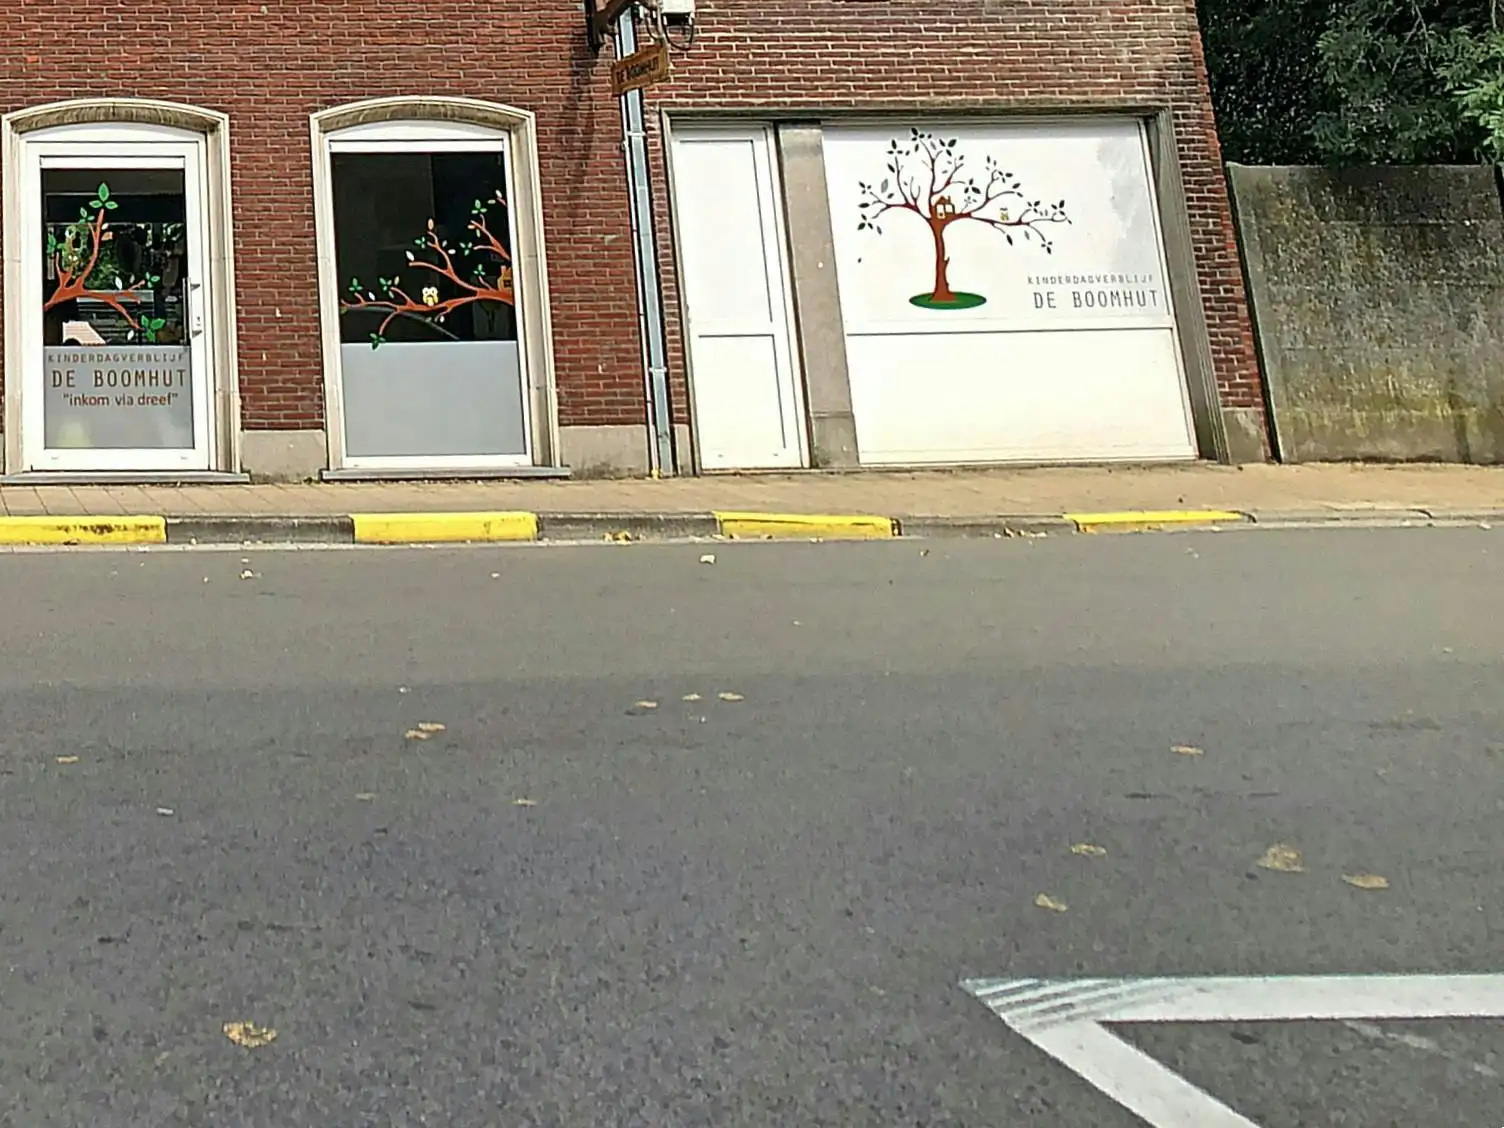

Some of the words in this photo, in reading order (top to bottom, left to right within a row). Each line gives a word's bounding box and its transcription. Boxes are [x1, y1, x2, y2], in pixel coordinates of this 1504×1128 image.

[1033, 291, 1057, 309] DE
[1071, 290, 1157, 308] BOOMHUT
[48, 353, 184, 363] KINDERDAGVERBLIJF
[52, 370, 76, 388] DE
[94, 369, 186, 388] BOOMHUT
[115, 393, 134, 406] via
